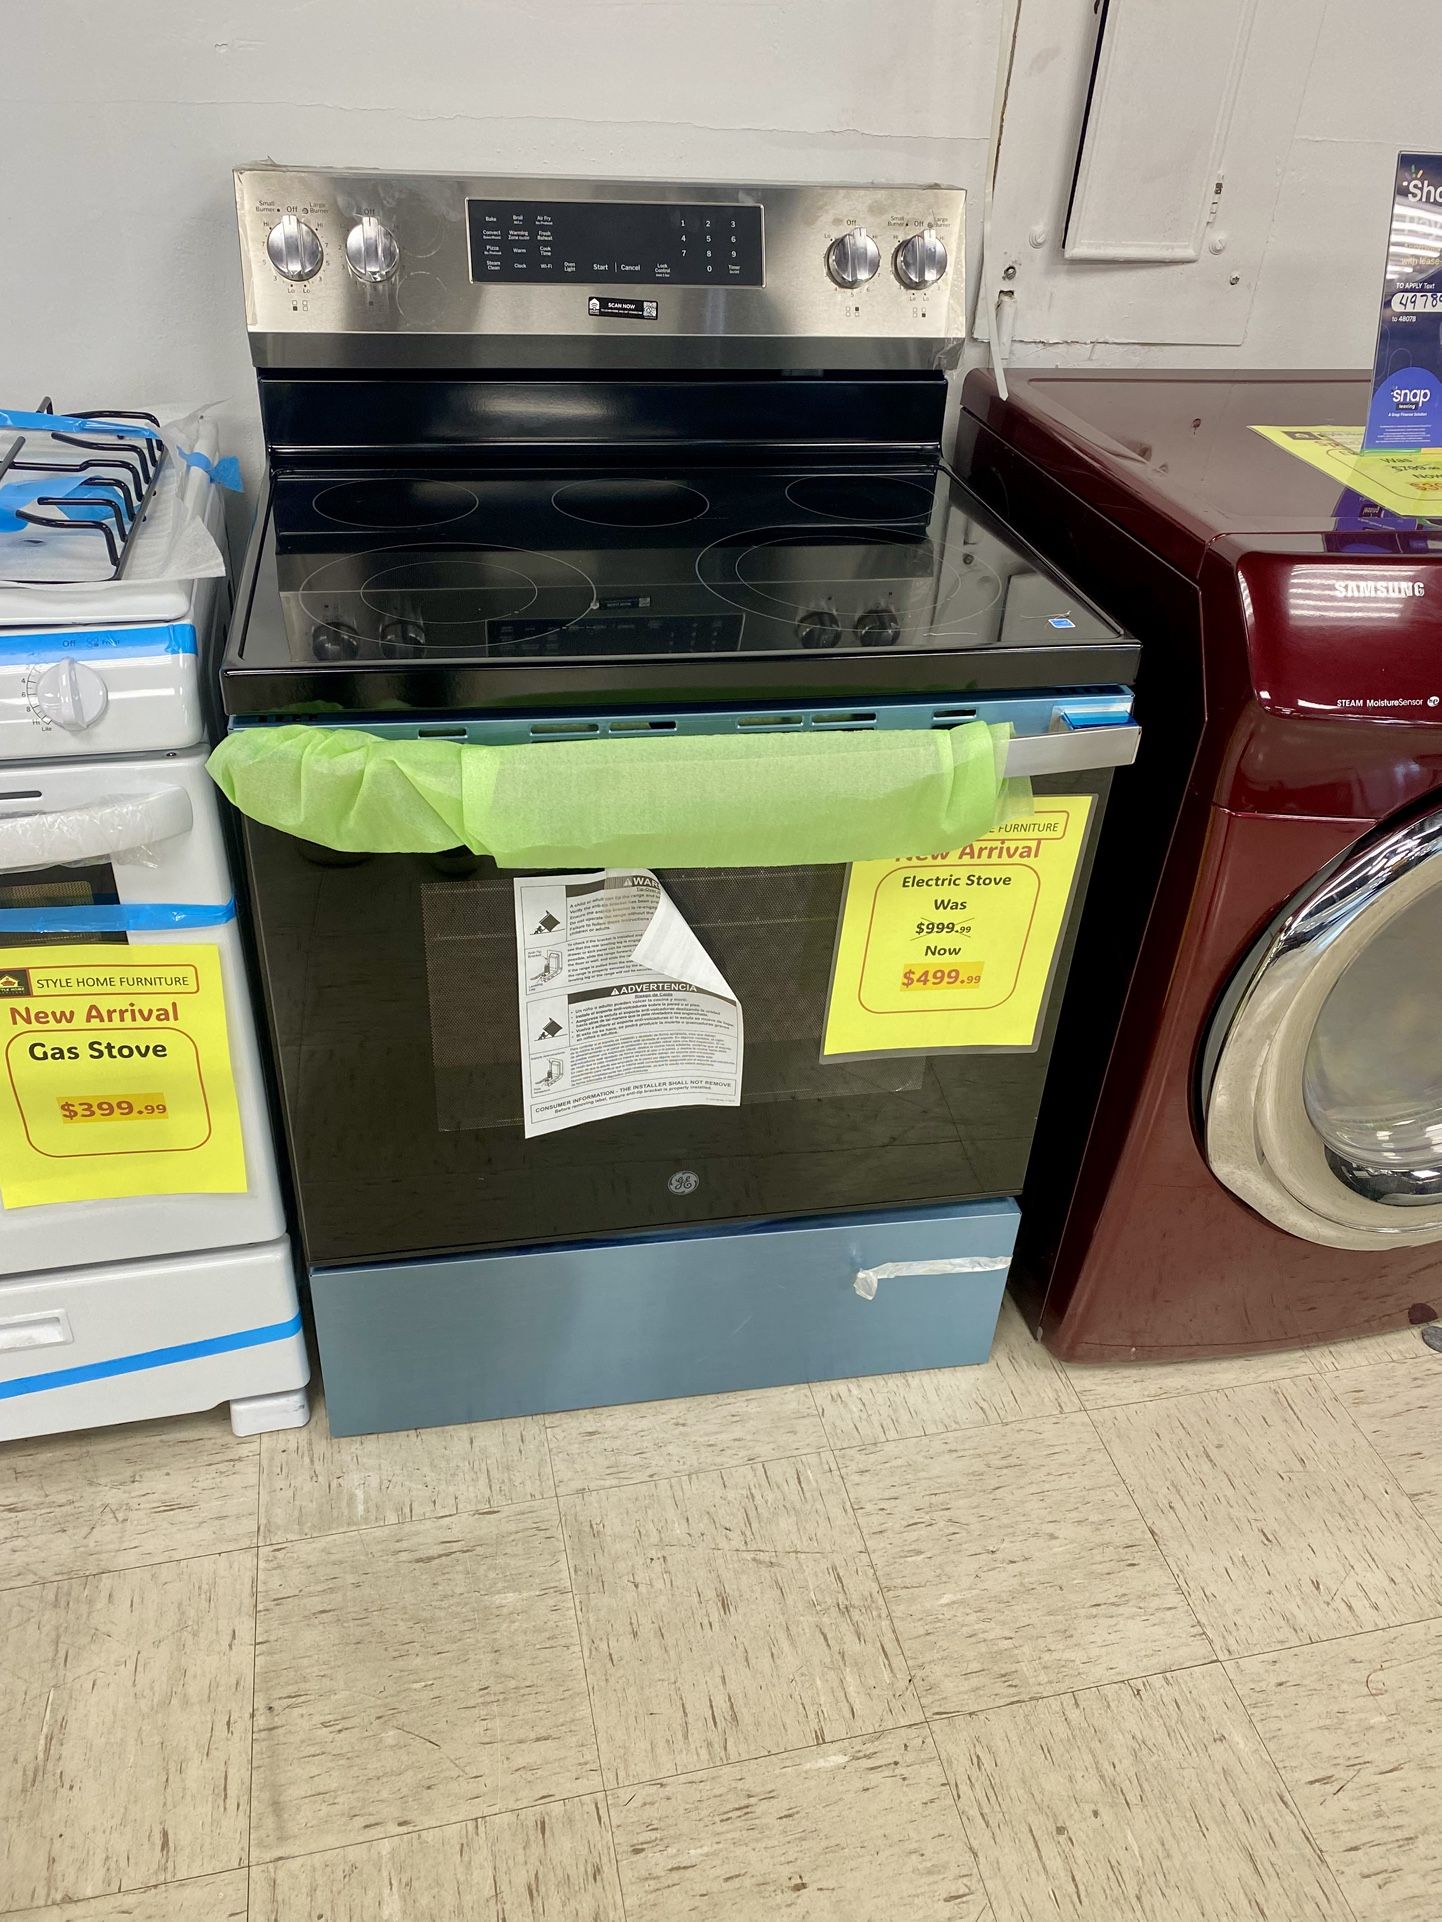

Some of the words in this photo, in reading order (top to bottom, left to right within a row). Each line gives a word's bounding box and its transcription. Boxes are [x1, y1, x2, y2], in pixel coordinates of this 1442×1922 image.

[1392, 389, 1430, 407] snap
[1334, 581, 1424, 598] SAMSUNG
[62, 640, 76, 648] Off
[1366, 698, 1424, 708] MoistureSensor
[998, 822, 1060, 834] FURNITURE
[958, 840, 1041, 860] Arrival
[902, 874, 962, 888] Electric
[965, 874, 1012, 886] Stove
[934, 898, 968, 910] Was
[915, 922, 972, 935] $999.99
[924, 946, 962, 956] Now
[36, 978, 73, 989] STYLE
[77, 977, 116, 988] HOME
[120, 976, 190, 986] FURNITURE
[902, 968, 982, 988] $499.99
[620, 984, 698, 994] ADVERTENCIA
[9, 1006, 75, 1025] New
[86, 1002, 180, 1023] Arrival
[28, 1042, 80, 1061] Gas
[88, 1040, 168, 1060] Stove
[536, 1100, 571, 1113] CONSUMER
[572, 1090, 615, 1104] INFORMATION
[632, 1082, 667, 1090] INSTALLER
[704, 1080, 731, 1088] REMOVE
[60, 1100, 167, 1120] $399.99
[572, 1101, 594, 1109] removing
